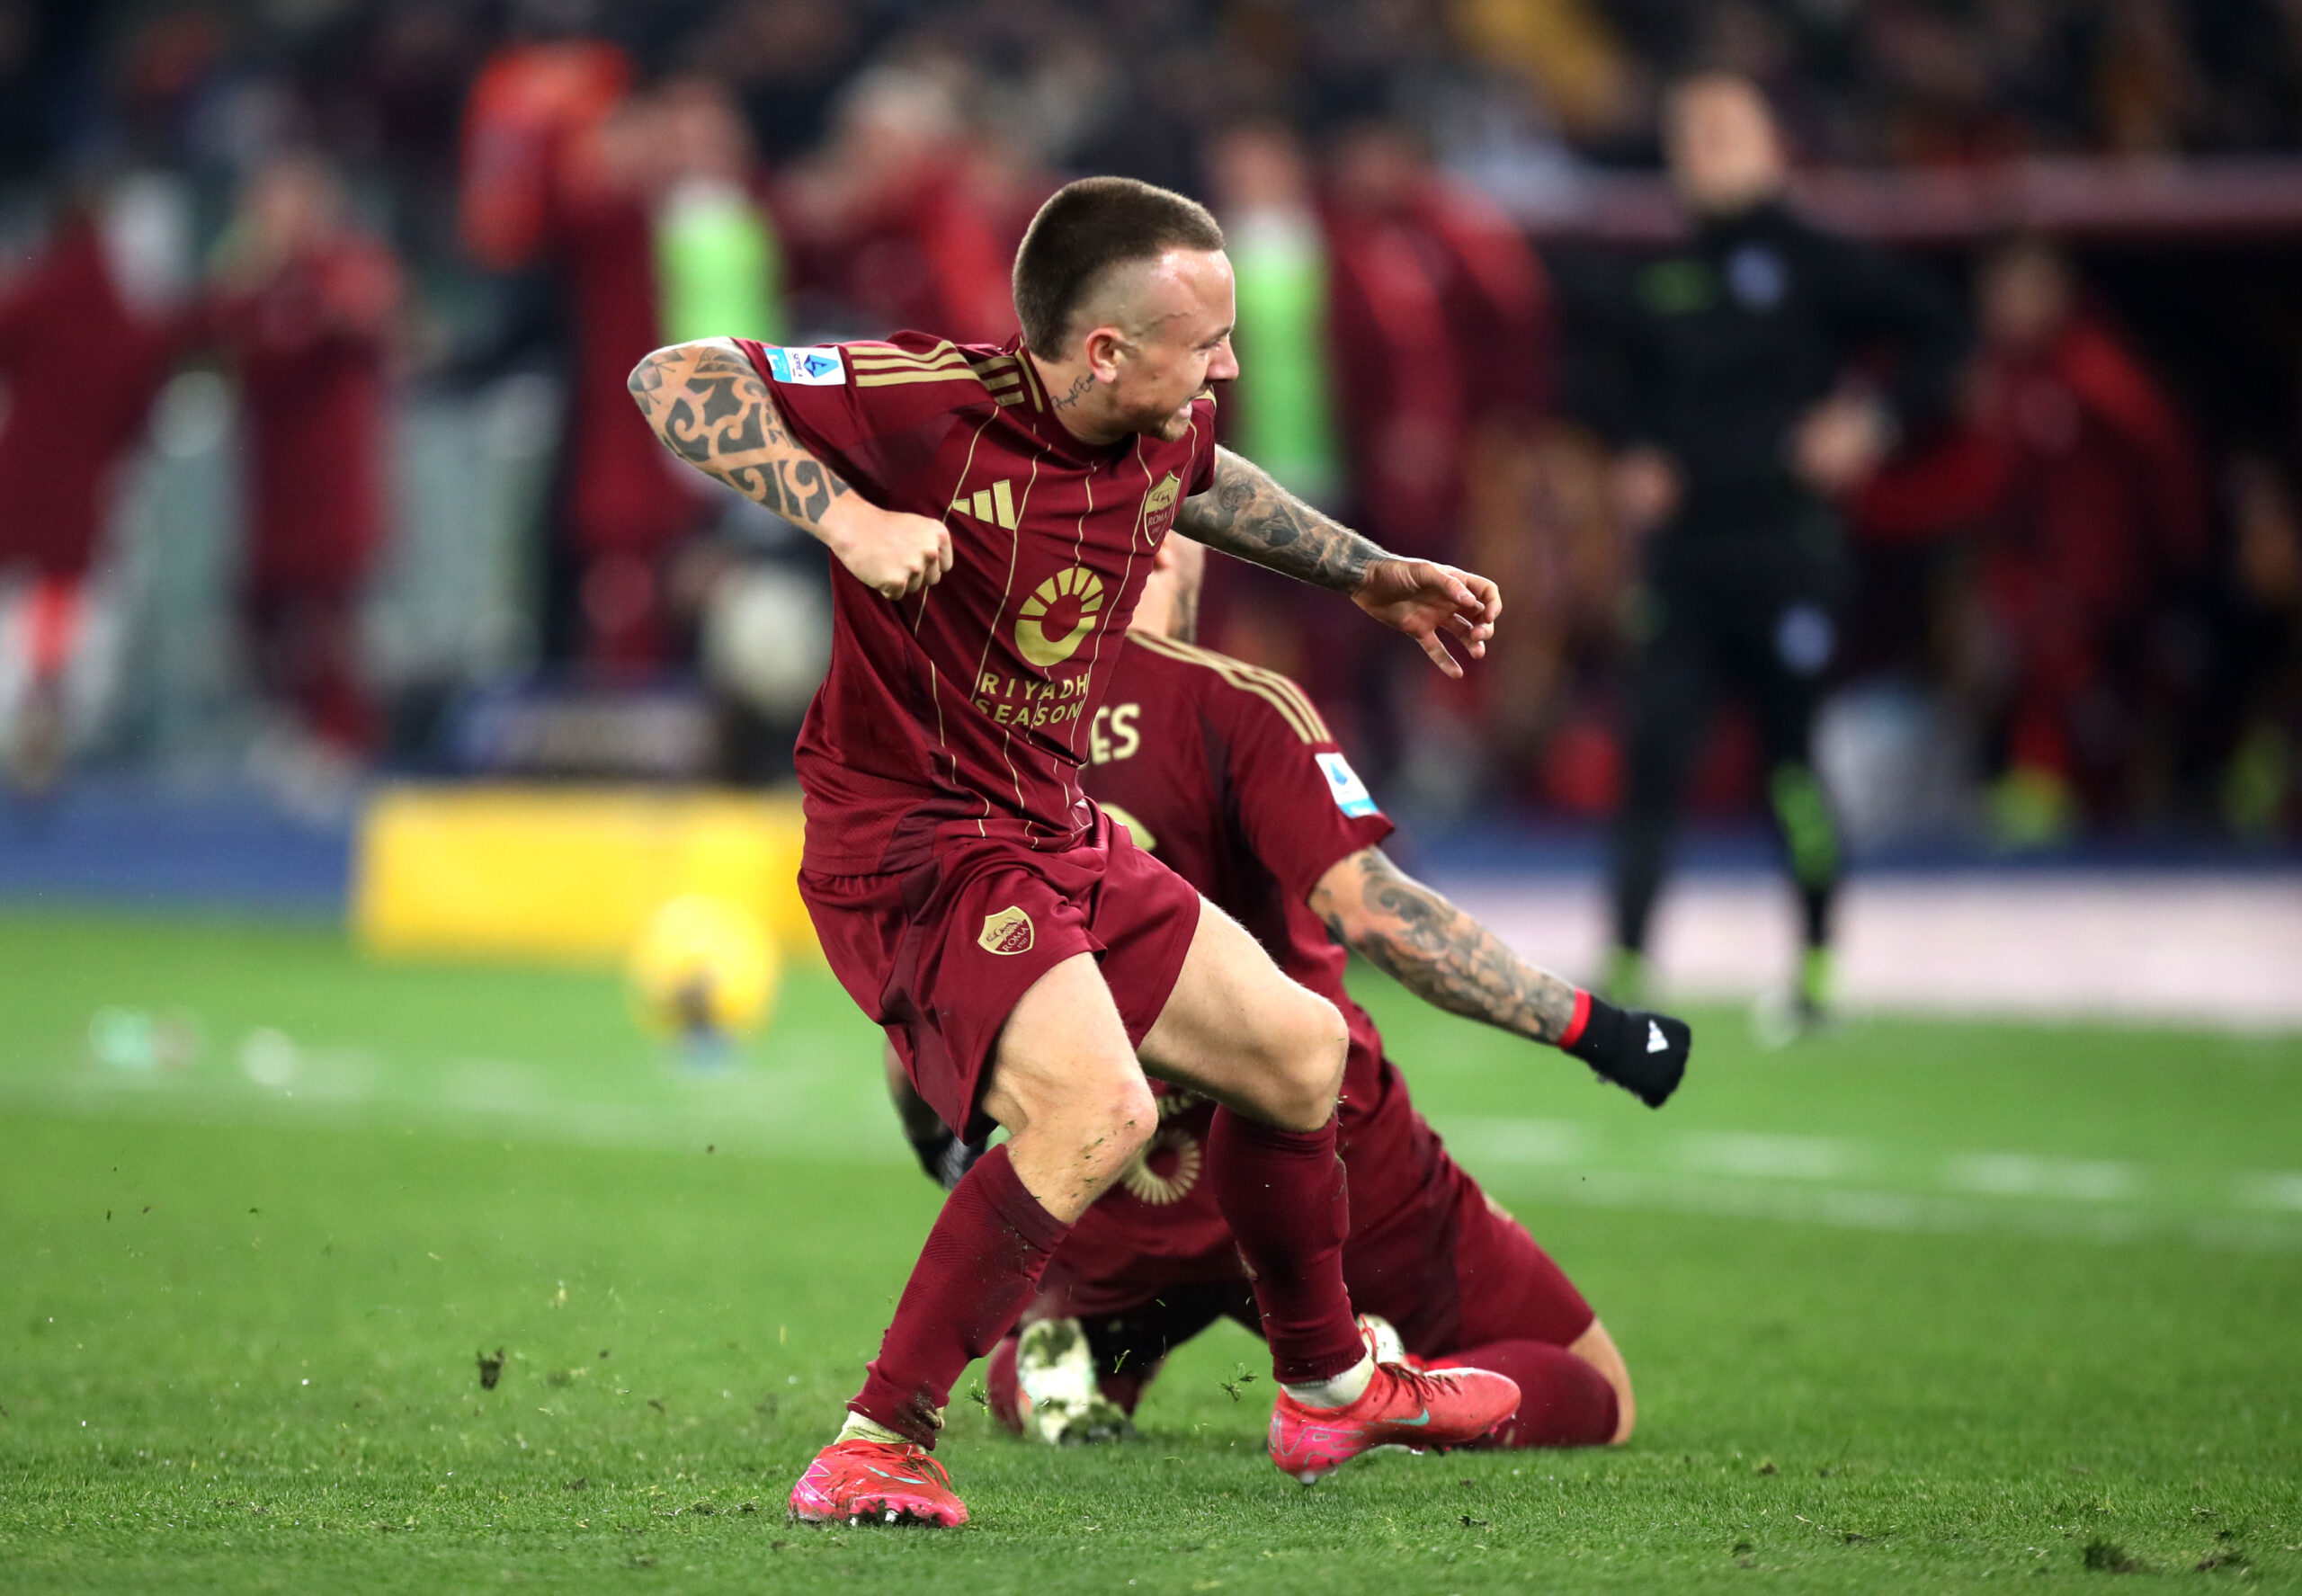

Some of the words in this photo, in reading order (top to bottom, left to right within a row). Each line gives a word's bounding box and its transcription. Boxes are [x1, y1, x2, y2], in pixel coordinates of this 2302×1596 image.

[979, 673, 1088, 700] RIYADH
[975, 699, 1083, 727] SEASON
[1002, 927, 1029, 951] ROMA
